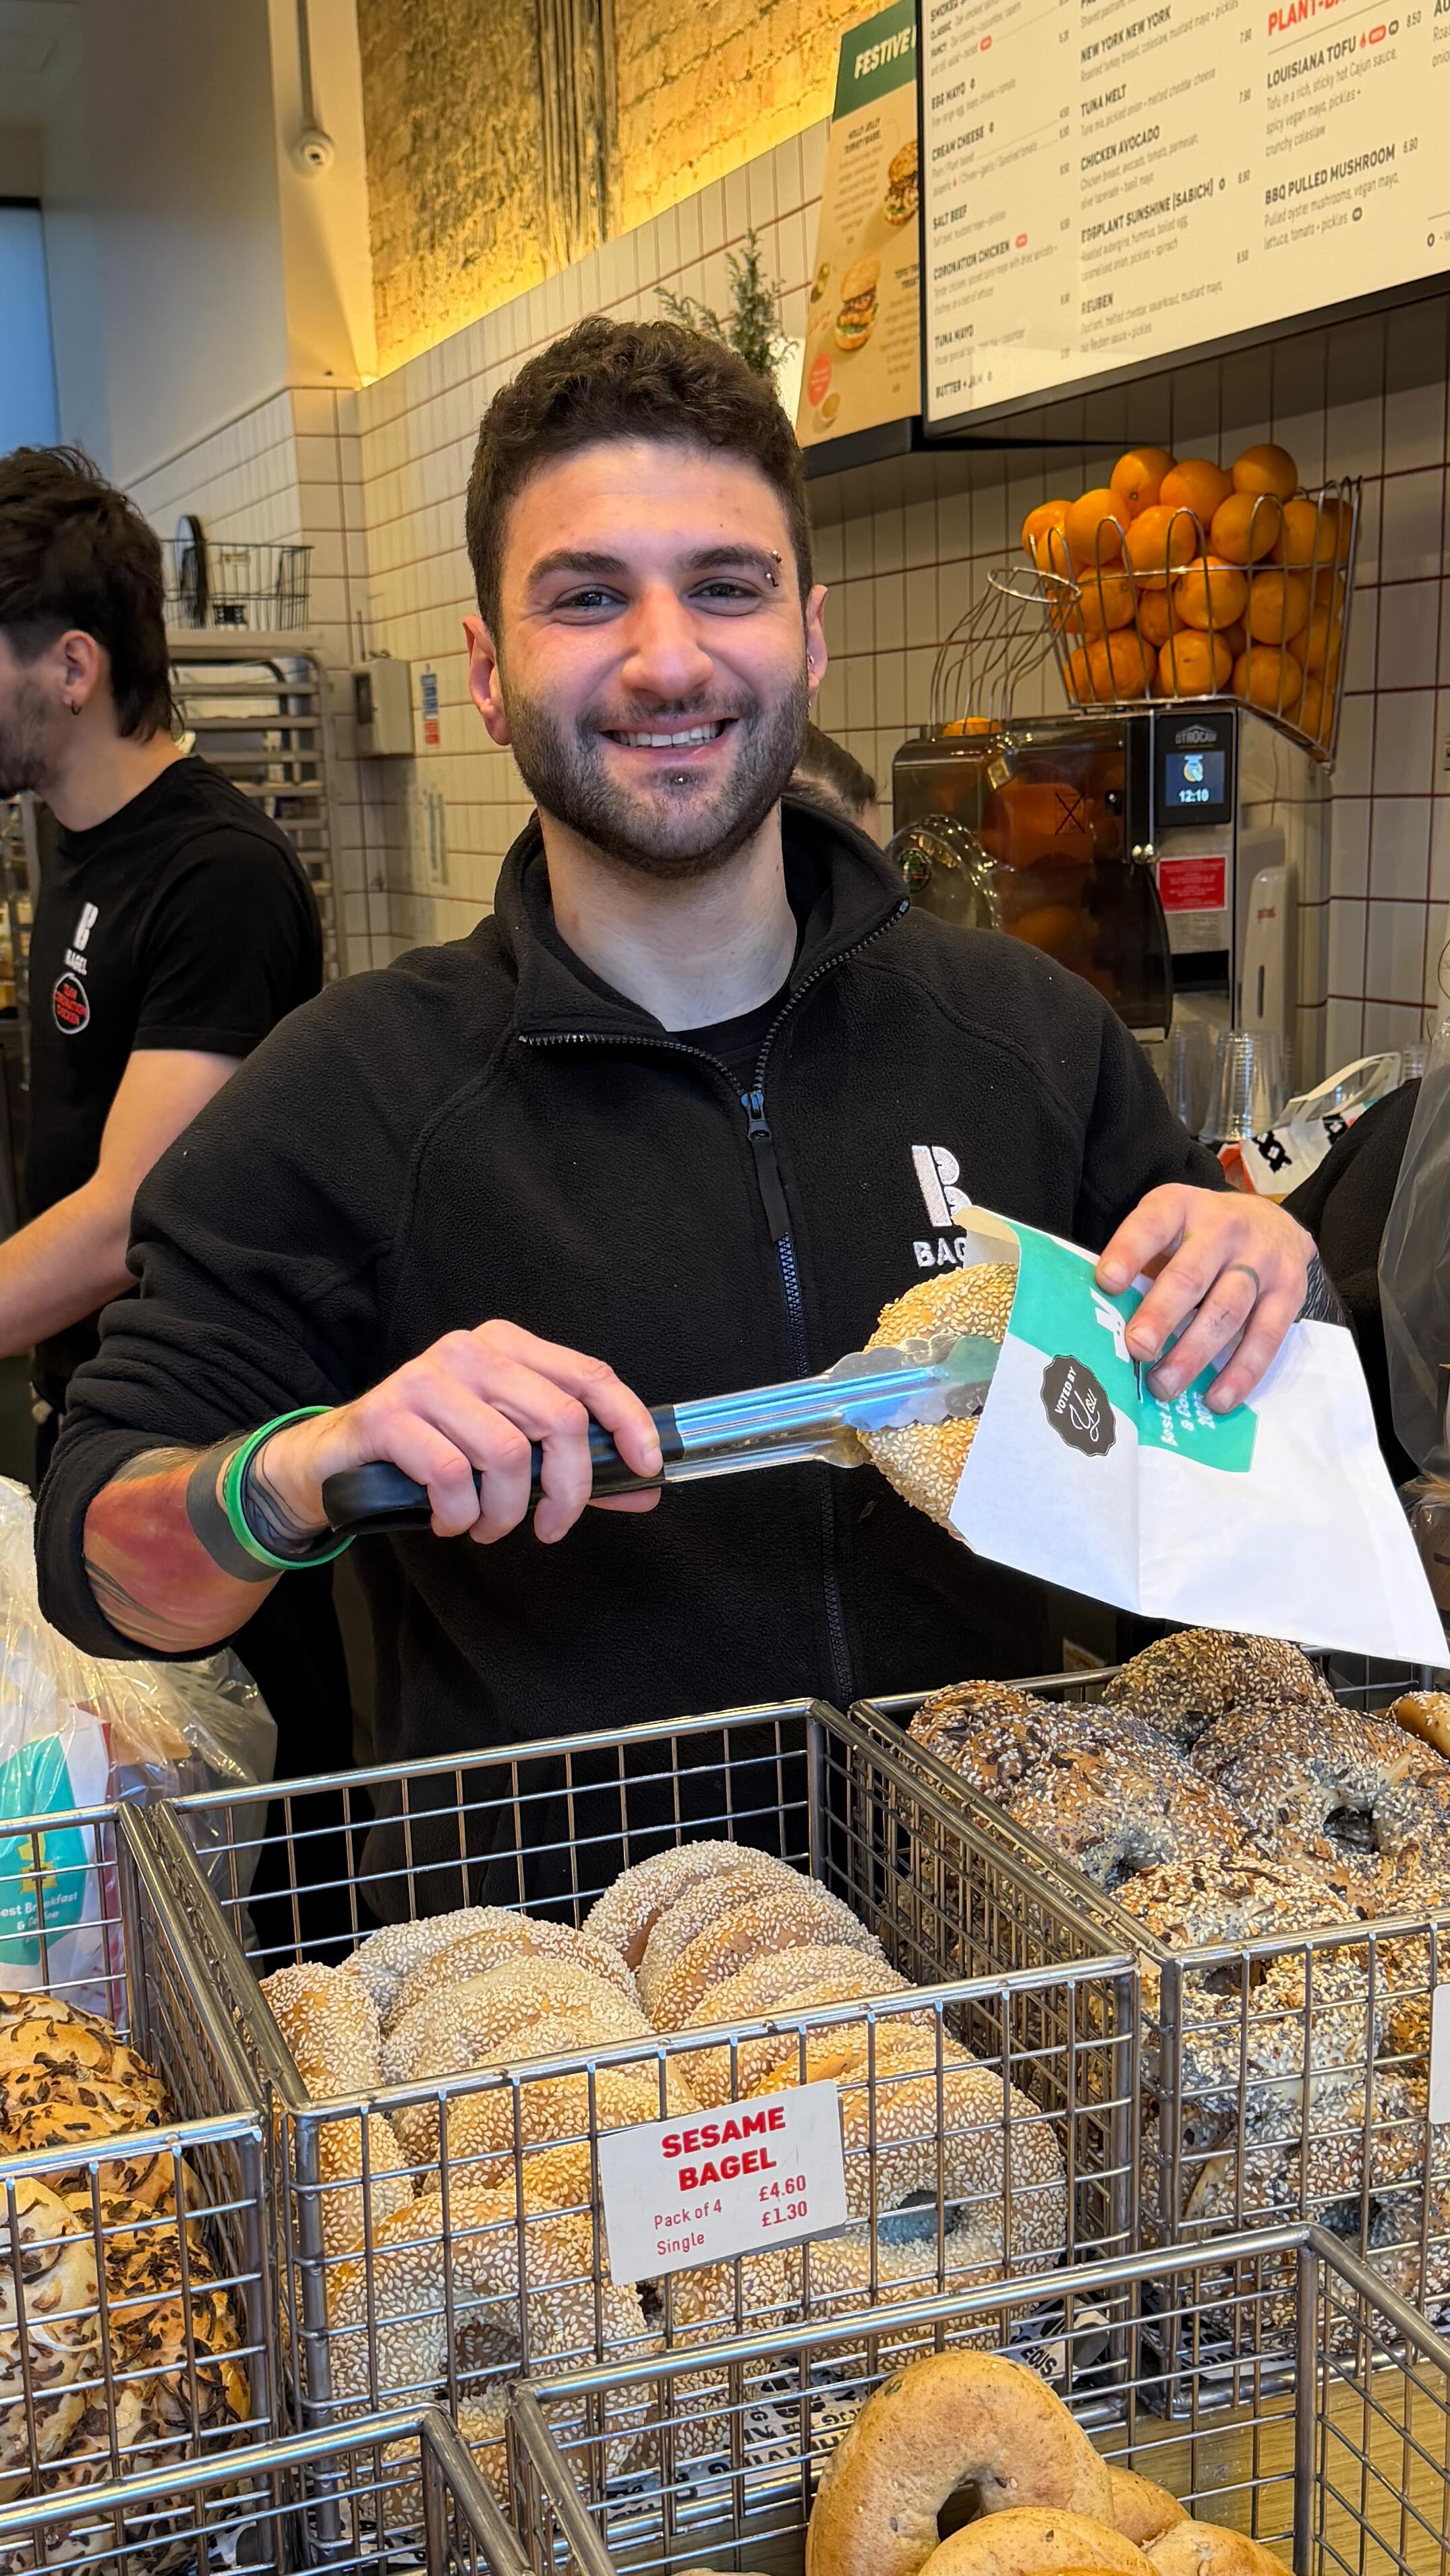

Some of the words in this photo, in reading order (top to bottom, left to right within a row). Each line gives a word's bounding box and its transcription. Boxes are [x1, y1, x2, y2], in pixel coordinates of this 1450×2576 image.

[854, 27, 909, 80] FESTIVE
[1080, 42, 1100, 63] NEW
[1101, 30, 1124, 53] YORK
[1126, 18, 1146, 40] NEW
[1147, 5, 1171, 30] YORK
[1267, 50, 1325, 88] LOUISIANA
[1327, 35, 1356, 63] TOFU
[1350, 58, 1371, 78] Cajun
[1080, 95, 1103, 117] TUNA
[1105, 84, 1127, 107] MELT
[932, 140, 955, 161] CREAM
[957, 125, 984, 150] CHEESE
[1080, 143, 1117, 171] CHICKEN
[1118, 125, 1160, 156] AVOCADO
[1265, 184, 1286, 206] BBQ
[1288, 169, 1328, 198] PULLED
[1330, 144, 1395, 182] MUSHROOM
[933, 212, 949, 230] SALT
[951, 204, 967, 223] BEEF
[1081, 215, 1124, 243] EGGPLANT
[1126, 196, 1171, 227] SUNSHINE
[934, 254, 977, 281] CORONATION
[979, 241, 1010, 263] CHICKEN
[1081, 292, 1114, 315] REUBEN
[1179, 788, 1209, 802] 12:10
[65, 948, 88, 976] BAGEL
[912, 1237, 966, 1267] BAG
[1054, 1380, 1072, 1414] VOTED
[1067, 1366, 1076, 1382] BY
[25, 1892, 78, 1914] Brakfast
[662, 2106, 786, 2159] SESAME
[678, 2147, 777, 2192] BAGEL
[654, 2208, 691, 2229] Pack
[695, 2202, 709, 2219] of
[713, 2198, 722, 2213] 4
[759, 2175, 807, 2202] £4.60
[657, 2232, 705, 2255] Single
[761, 2200, 808, 2227] £1.30
